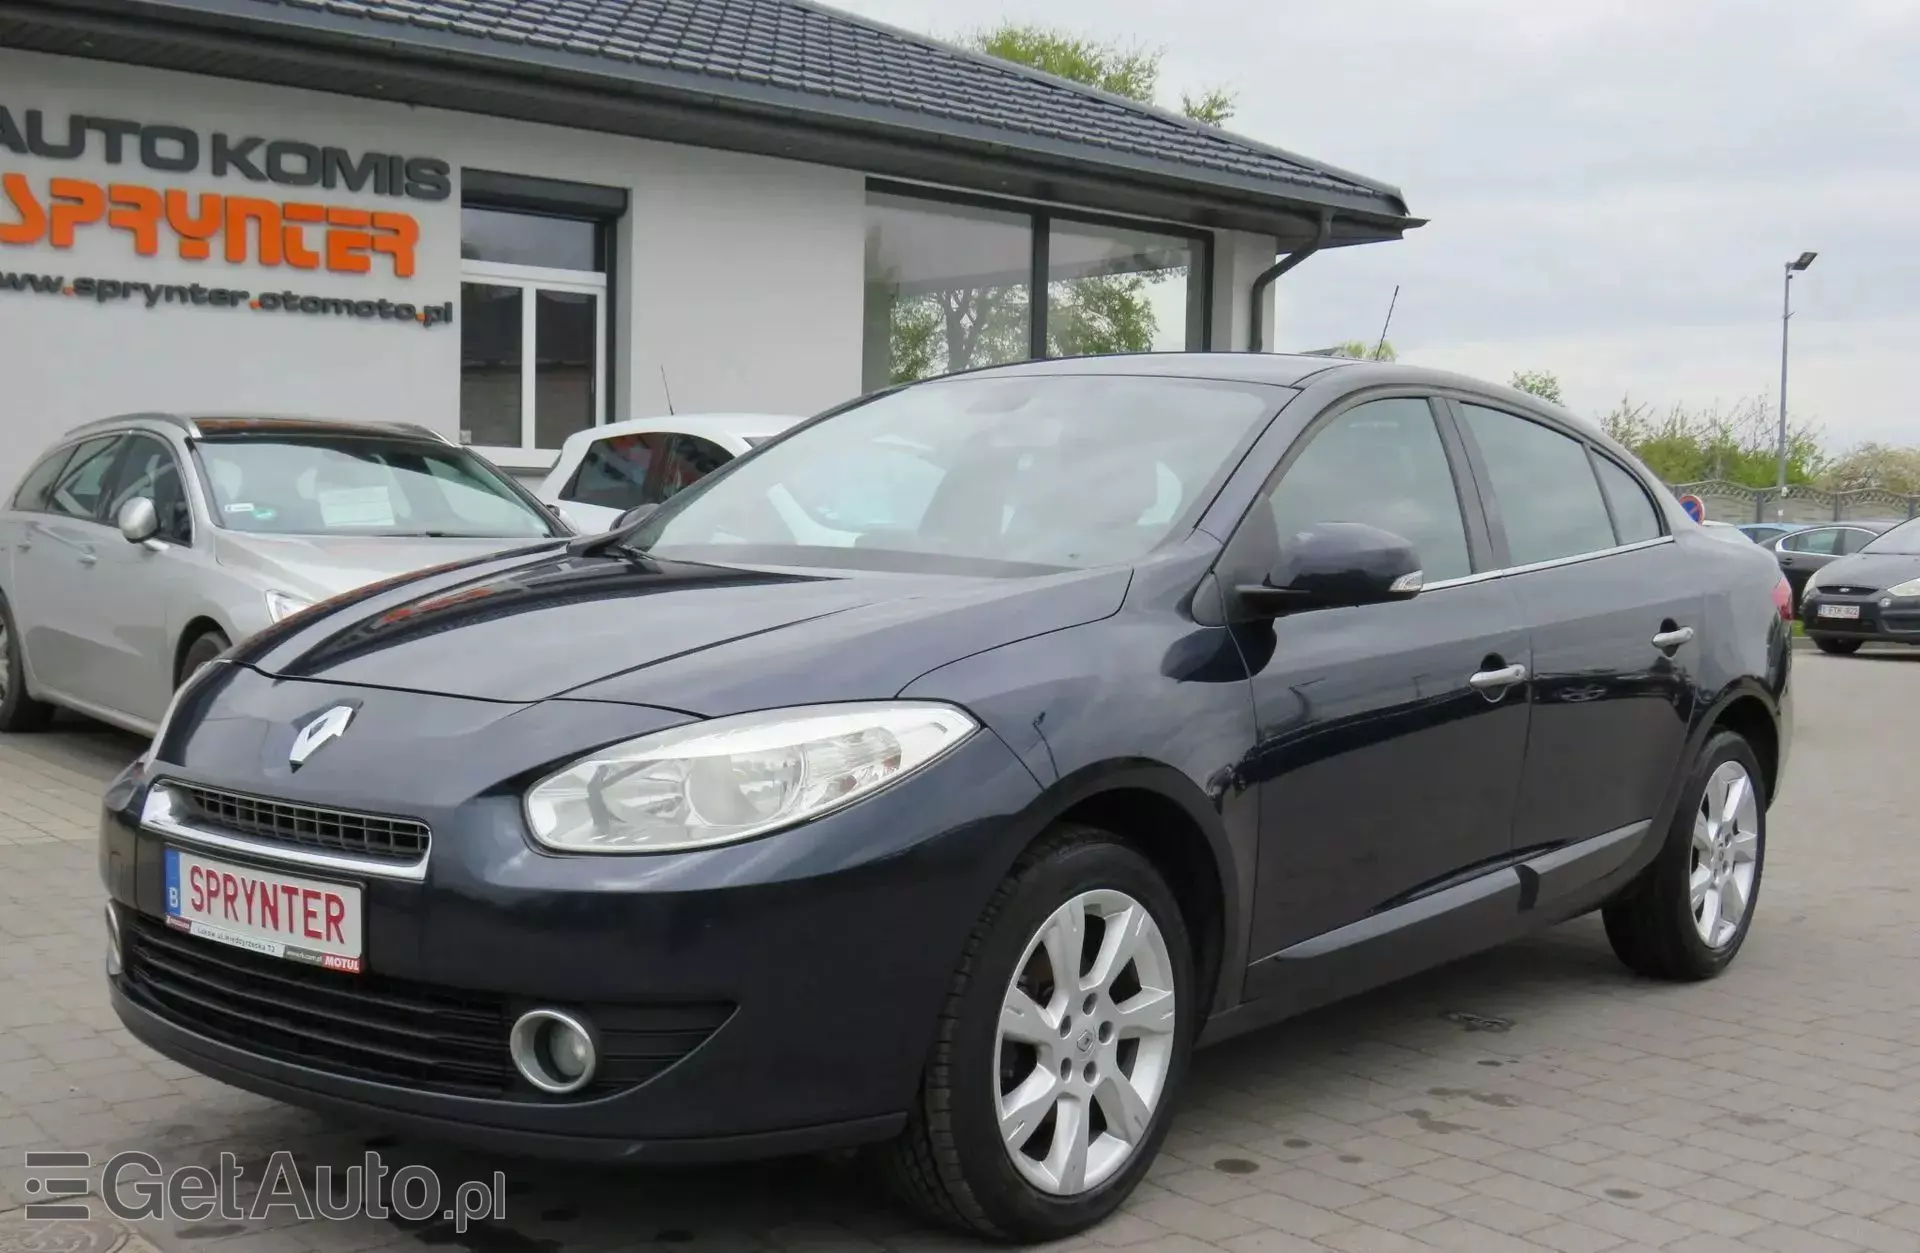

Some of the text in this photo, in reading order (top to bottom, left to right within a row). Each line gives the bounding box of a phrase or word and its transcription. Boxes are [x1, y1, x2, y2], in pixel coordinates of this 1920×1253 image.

[212, 133, 450, 200] KOMIS
[0, 173, 419, 277] SPRYNTER
[168, 864, 345, 944] B SPRYNTER
[325, 955, 360, 971] MOTUL
